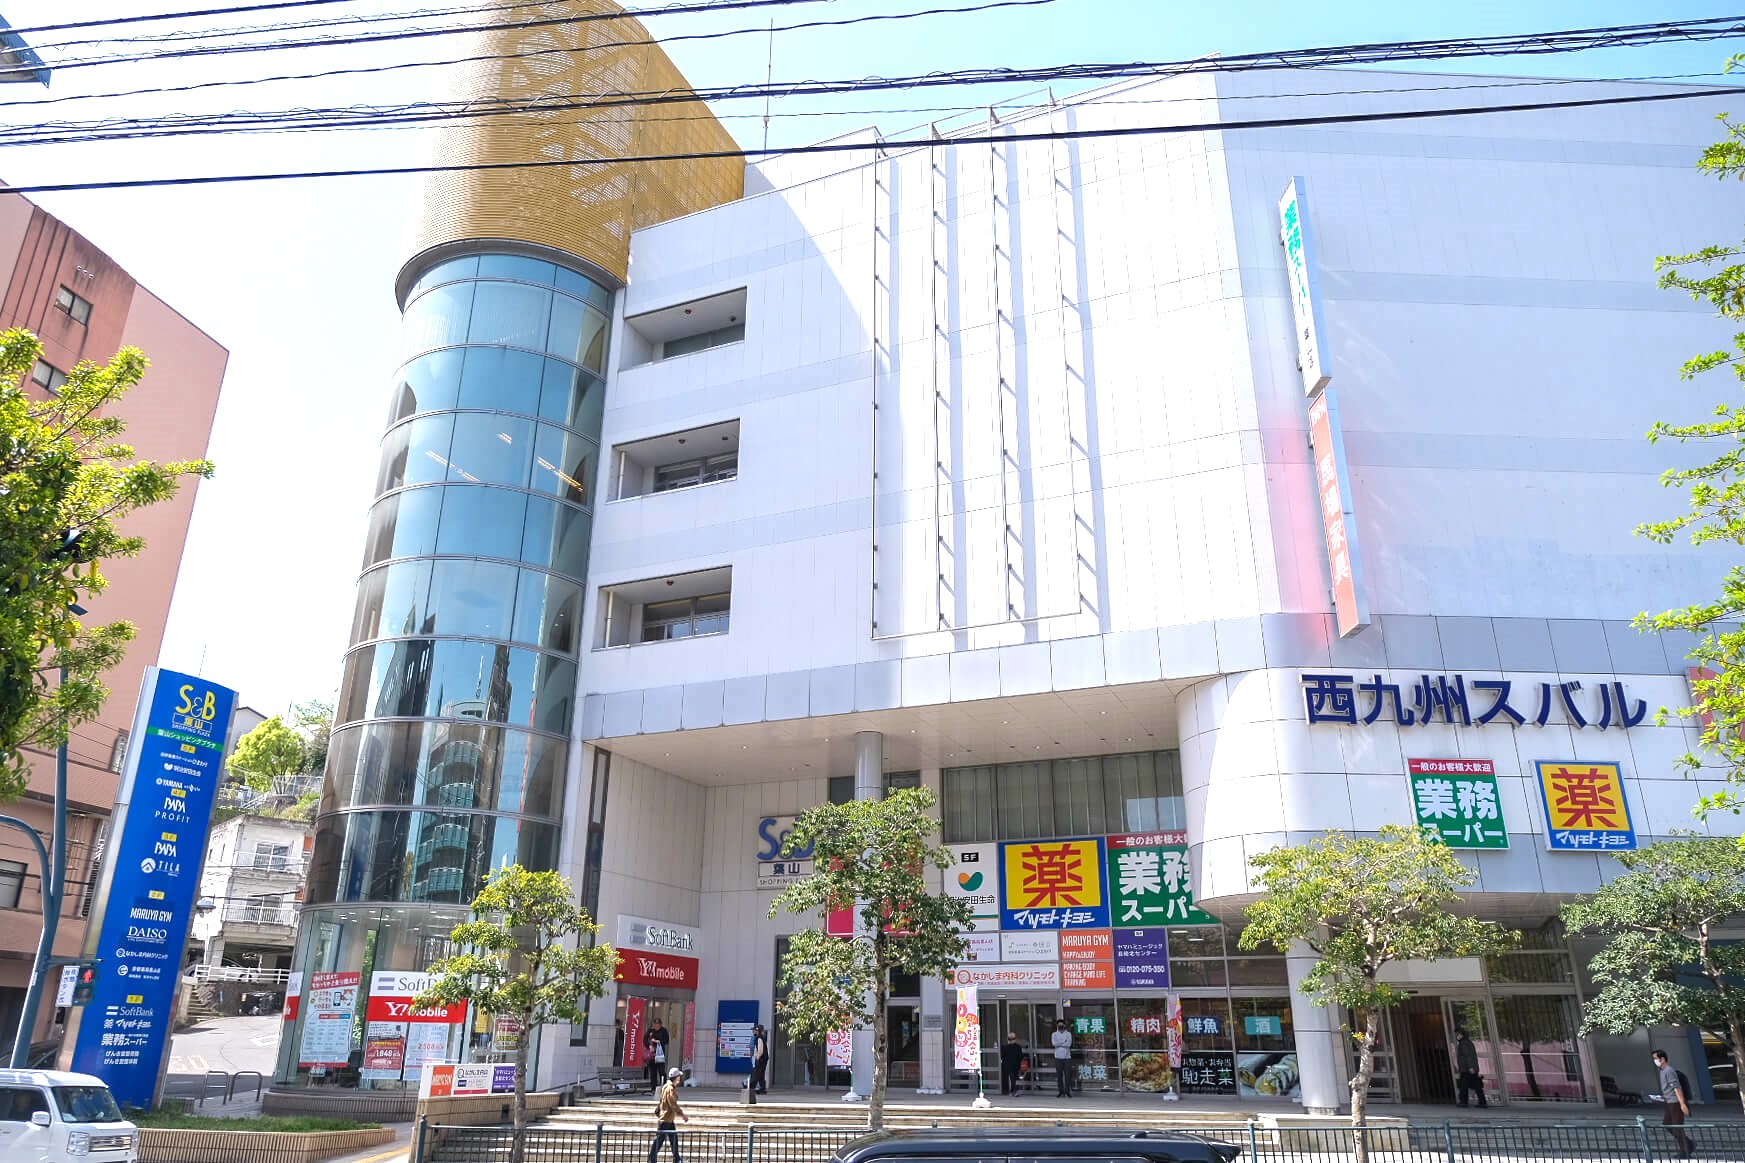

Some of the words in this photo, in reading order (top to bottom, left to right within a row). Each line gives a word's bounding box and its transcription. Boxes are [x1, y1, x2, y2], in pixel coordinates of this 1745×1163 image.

[1319, 452, 1350, 586] 馬場家具
[175, 684, 216, 721] S&B
[1300, 673, 1648, 729] 西九州スバル
[1411, 761, 1491, 772] 一般のお客様大歓迎
[1415, 779, 1498, 819] 業務
[1551, 768, 1618, 828] 薬
[154, 810, 190, 823] PROFIT
[1556, 832, 1630, 848] マツモトキヨシ
[773, 862, 800, 874] 葉山
[1022, 843, 1084, 907] 薬
[130, 907, 158, 921] MARUYA
[159, 910, 172, 922] GYM
[1013, 908, 1095, 928] マツモトキヨシ
[128, 926, 167, 939] DAISO
[647, 926, 694, 951] SoftBank
[1062, 936, 1092, 946] MARUYA
[1093, 935, 1109, 946] GYM
[638, 957, 684, 981] Y!mobile
[973, 970, 1055, 981] なかしま内科クリニック
[120, 1007, 154, 1016] SoftBank
[1075, 1017, 1105, 1034] 青果
[1130, 1017, 1161, 1033] 精肉
[1187, 1017, 1219, 1034] 鮮魚
[1255, 1018, 1271, 1033] 酒
[101, 1033, 148, 1046] 業務スーパー
[1077, 1064, 1108, 1080] 惣菜
[1182, 1067, 1234, 1085] 馳走菜
